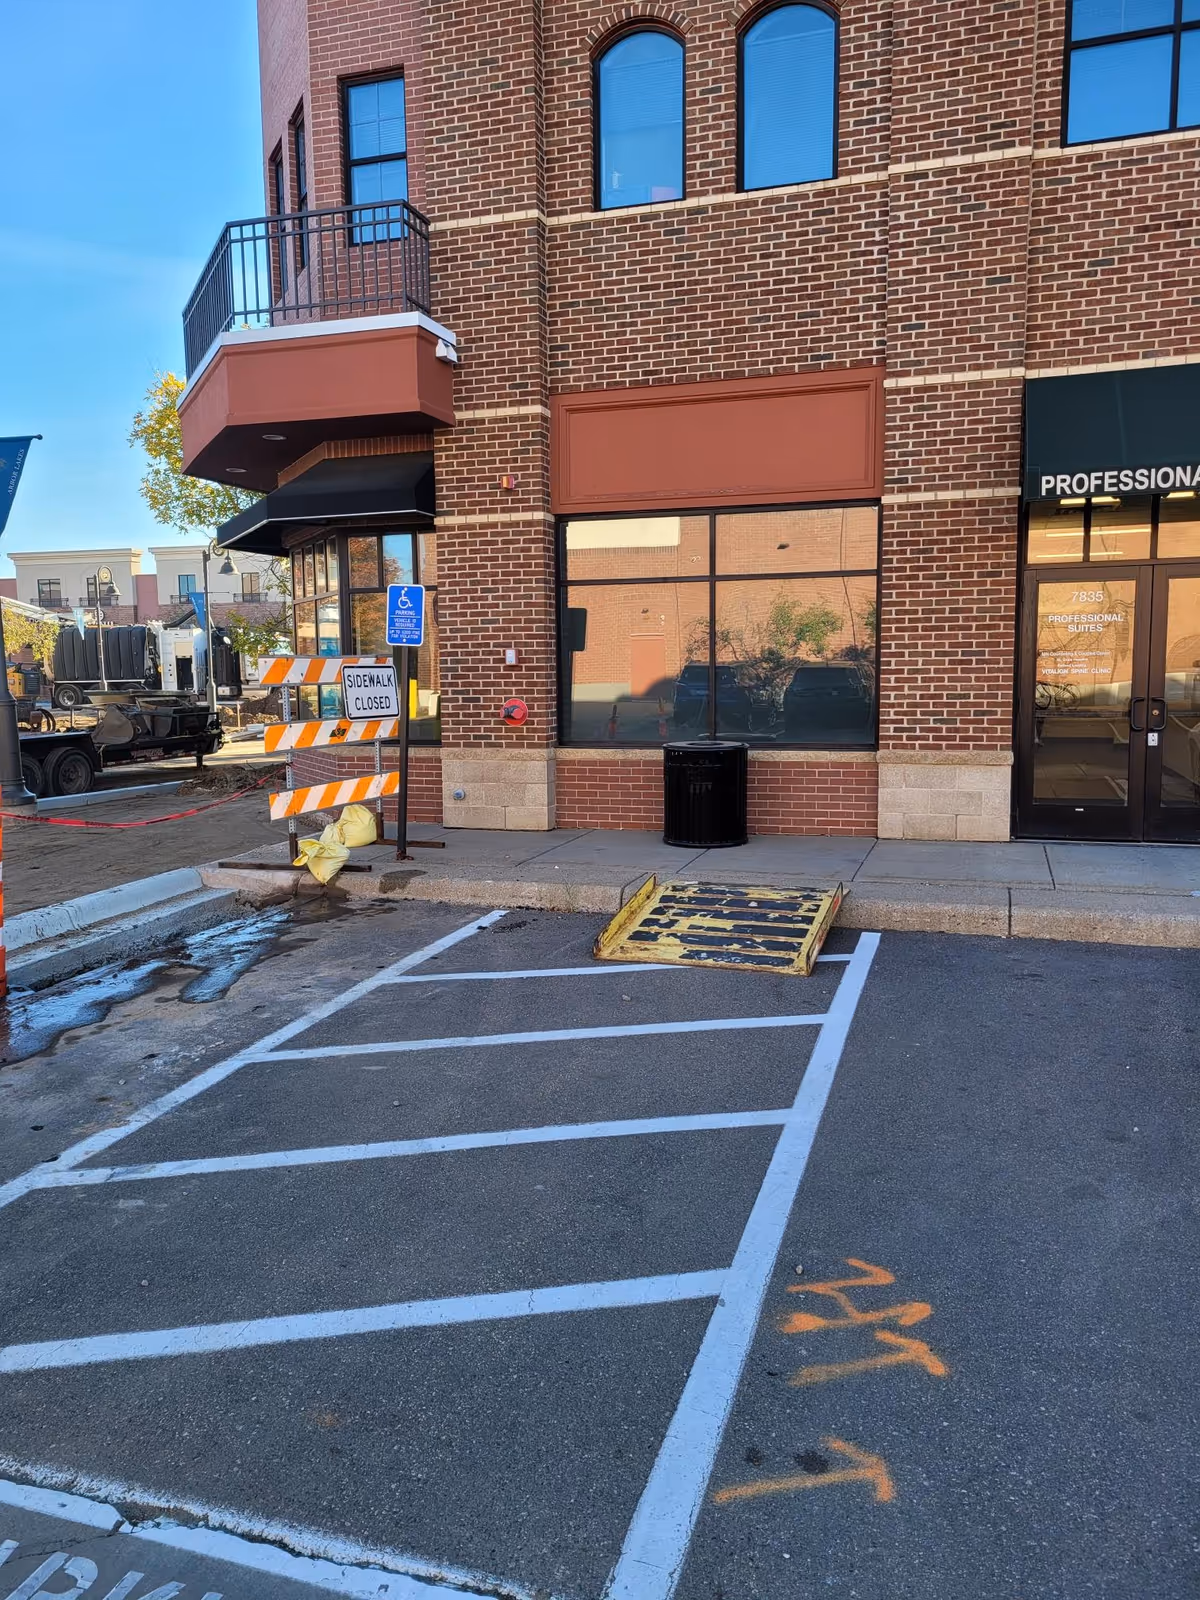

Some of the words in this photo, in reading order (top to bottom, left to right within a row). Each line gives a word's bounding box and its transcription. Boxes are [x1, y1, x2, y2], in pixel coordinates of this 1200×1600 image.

[8, 472, 18, 495] ARBOR
[14, 449, 24, 470] LAKES
[1072, 591, 1104, 602] 7835
[1048, 614, 1124, 623] PROFESSIONAL
[1067, 624, 1103, 632] SUITES
[347, 674, 394, 688] SIDEWALK
[354, 696, 391, 710] CLOSED
